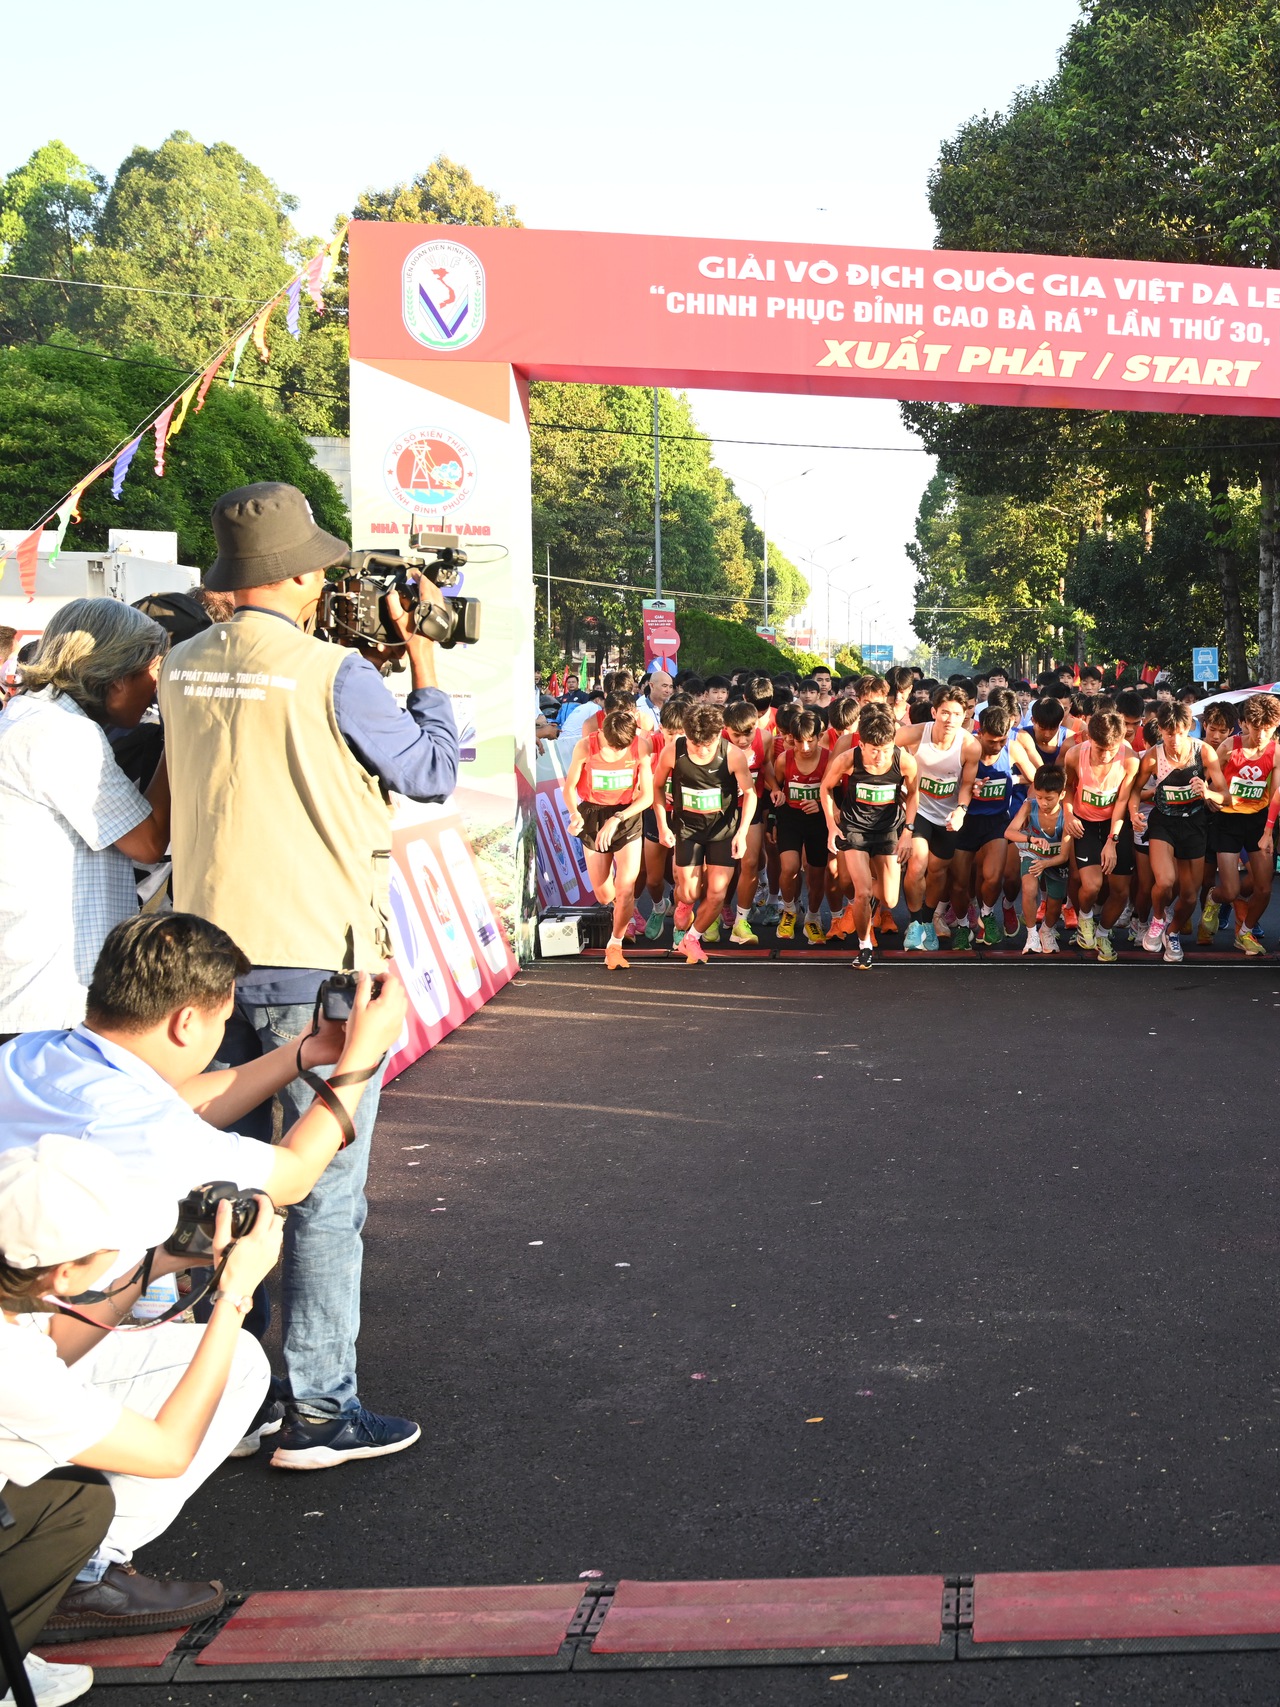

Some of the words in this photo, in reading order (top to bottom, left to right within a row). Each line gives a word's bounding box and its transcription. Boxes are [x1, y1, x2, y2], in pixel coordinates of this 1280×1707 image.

[698, 253, 776, 282] GIẢI
[846, 263, 925, 290] ĐỊCH
[932, 266, 1035, 296] QUỐC
[1042, 273, 1107, 300] GIA
[1114, 277, 1184, 305] VIỆT
[766, 296, 845, 326] PHỤC
[853, 295, 925, 326] ĐỈNH
[932, 304, 989, 329] CAO
[997, 305, 1037, 332] BÀ
[1106, 310, 1161, 338] LẦN
[1169, 315, 1227, 342] THỨ
[1229, 321, 1271, 347] 30,
[814, 329, 953, 373] XUẤT
[957, 341, 1088, 379] PHÁT
[1120, 354, 1262, 388] START
[370, 522, 399, 534] NHÀ
[455, 523, 491, 536] VÀNG
[181, 669, 203, 682] PHÁT
[202, 671, 230, 683] THANH
[184, 685, 196, 697] VÀ
[920, 778, 955, 795] M-1140
[979, 785, 1005, 798] -1147
